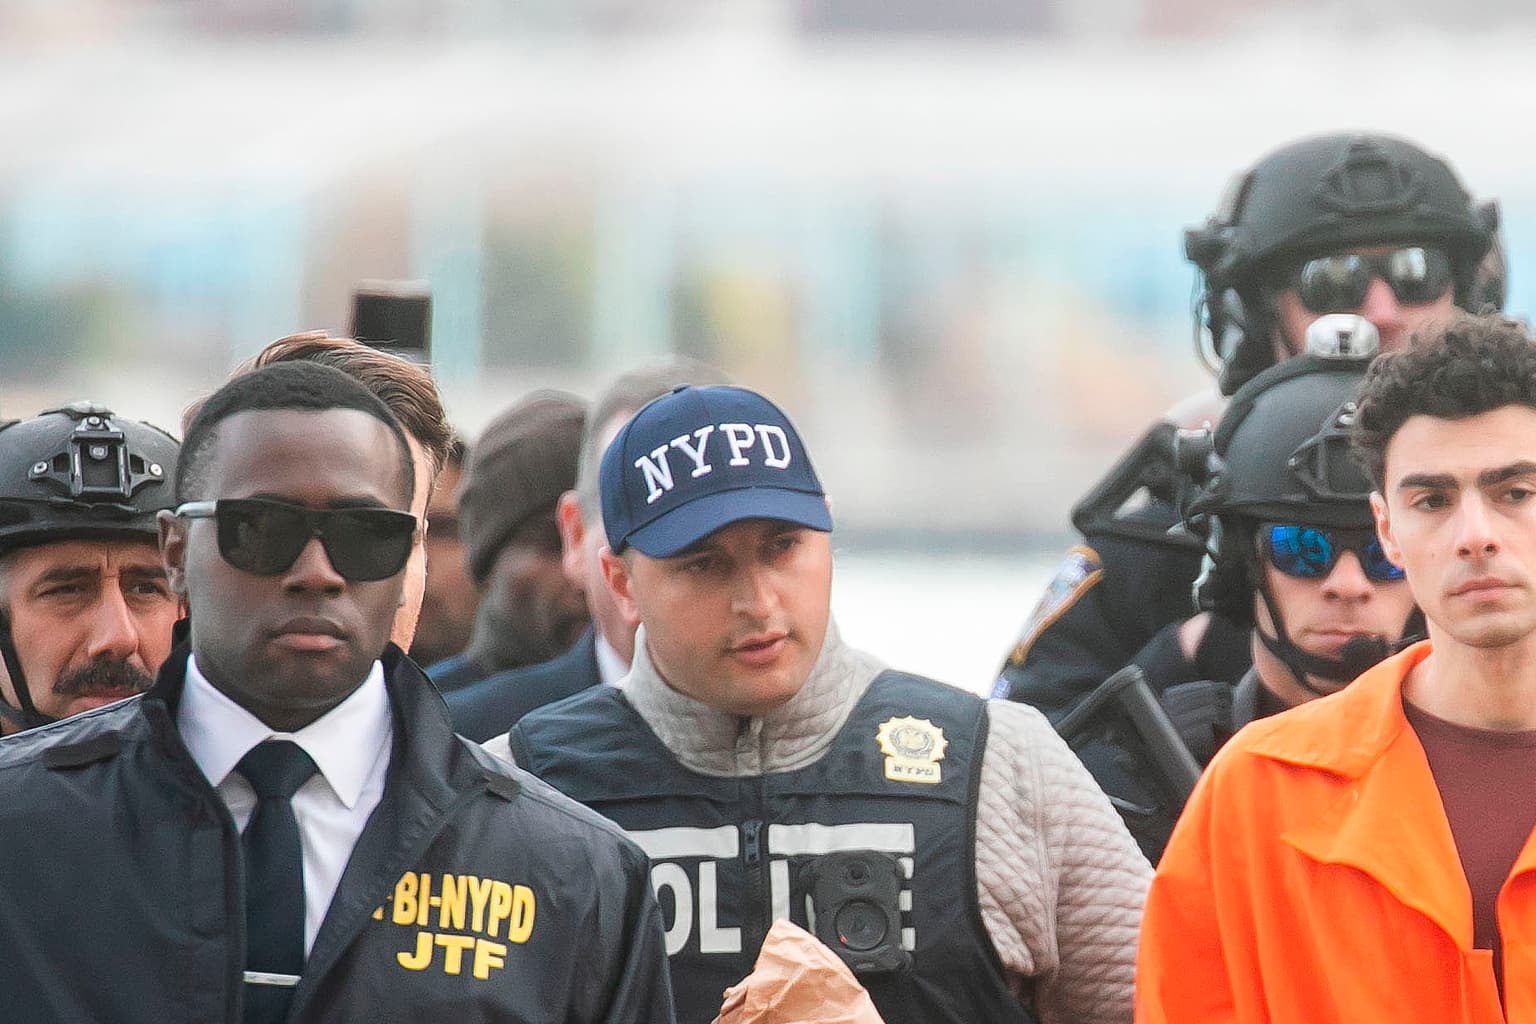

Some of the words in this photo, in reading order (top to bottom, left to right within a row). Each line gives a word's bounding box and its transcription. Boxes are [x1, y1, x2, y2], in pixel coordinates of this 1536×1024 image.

[634, 422, 792, 505] NYPD
[372, 870, 537, 945] BI-NYPD
[396, 931, 508, 980] JTF
